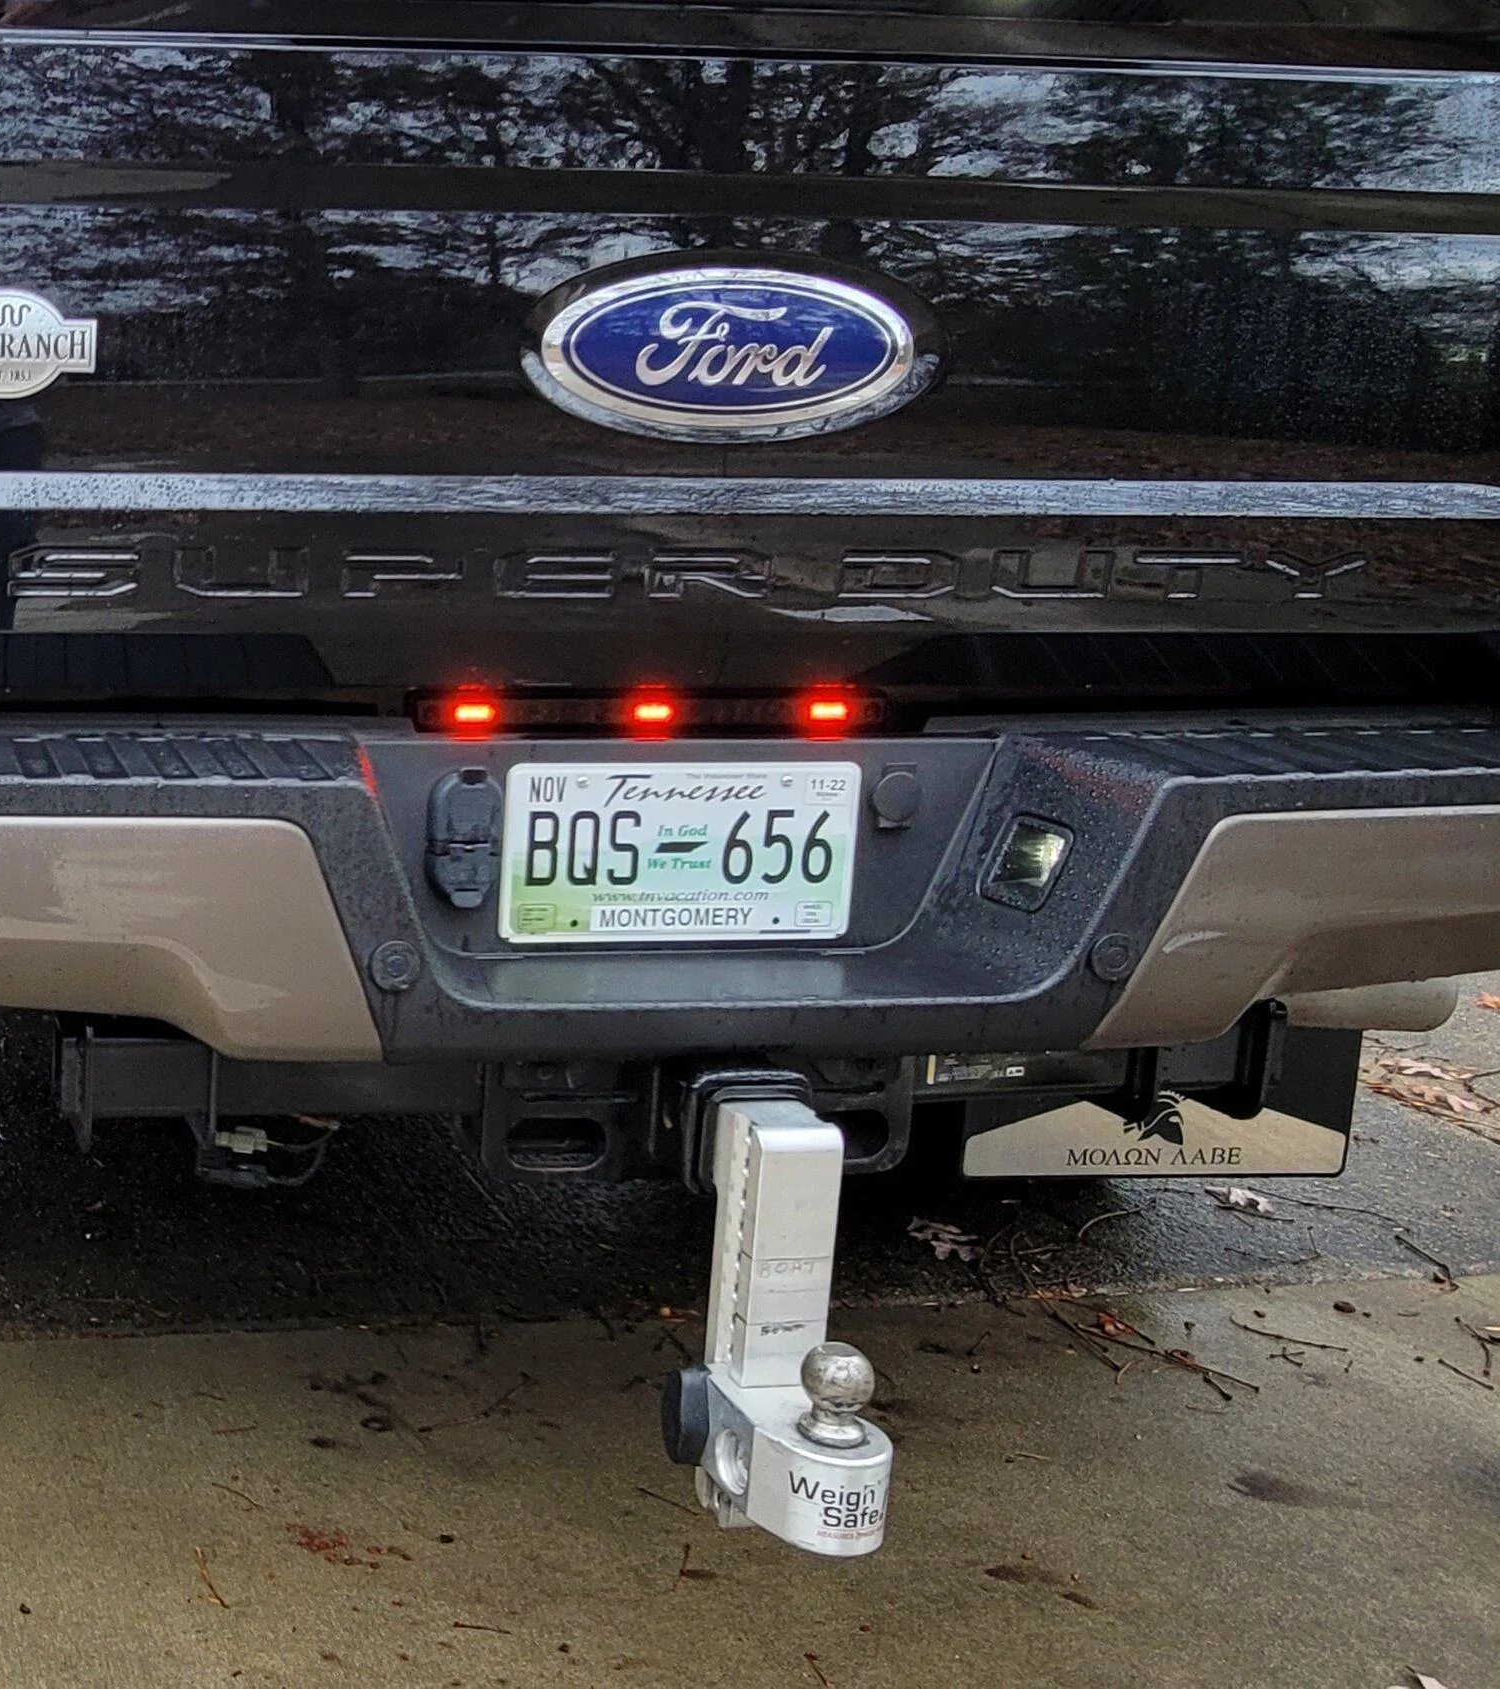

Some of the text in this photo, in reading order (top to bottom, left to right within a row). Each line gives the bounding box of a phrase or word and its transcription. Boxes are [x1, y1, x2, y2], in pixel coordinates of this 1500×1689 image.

[1, 330, 87, 361] RANCH
[635, 300, 834, 388] Ford
[7, 545, 1370, 600] SUPER DUTY
[529, 776, 568, 803] NOV
[603, 774, 768, 809] Tennessee
[810, 778, 846, 791] 11-22
[656, 823, 708, 837] In God
[525, 809, 833, 886] BQS 656
[647, 858, 712, 869] We Trust
[591, 889, 768, 903] www.tnvacation.com
[599, 907, 753, 928] MONTGOMERY
[821, 1506, 879, 1529] Safe
